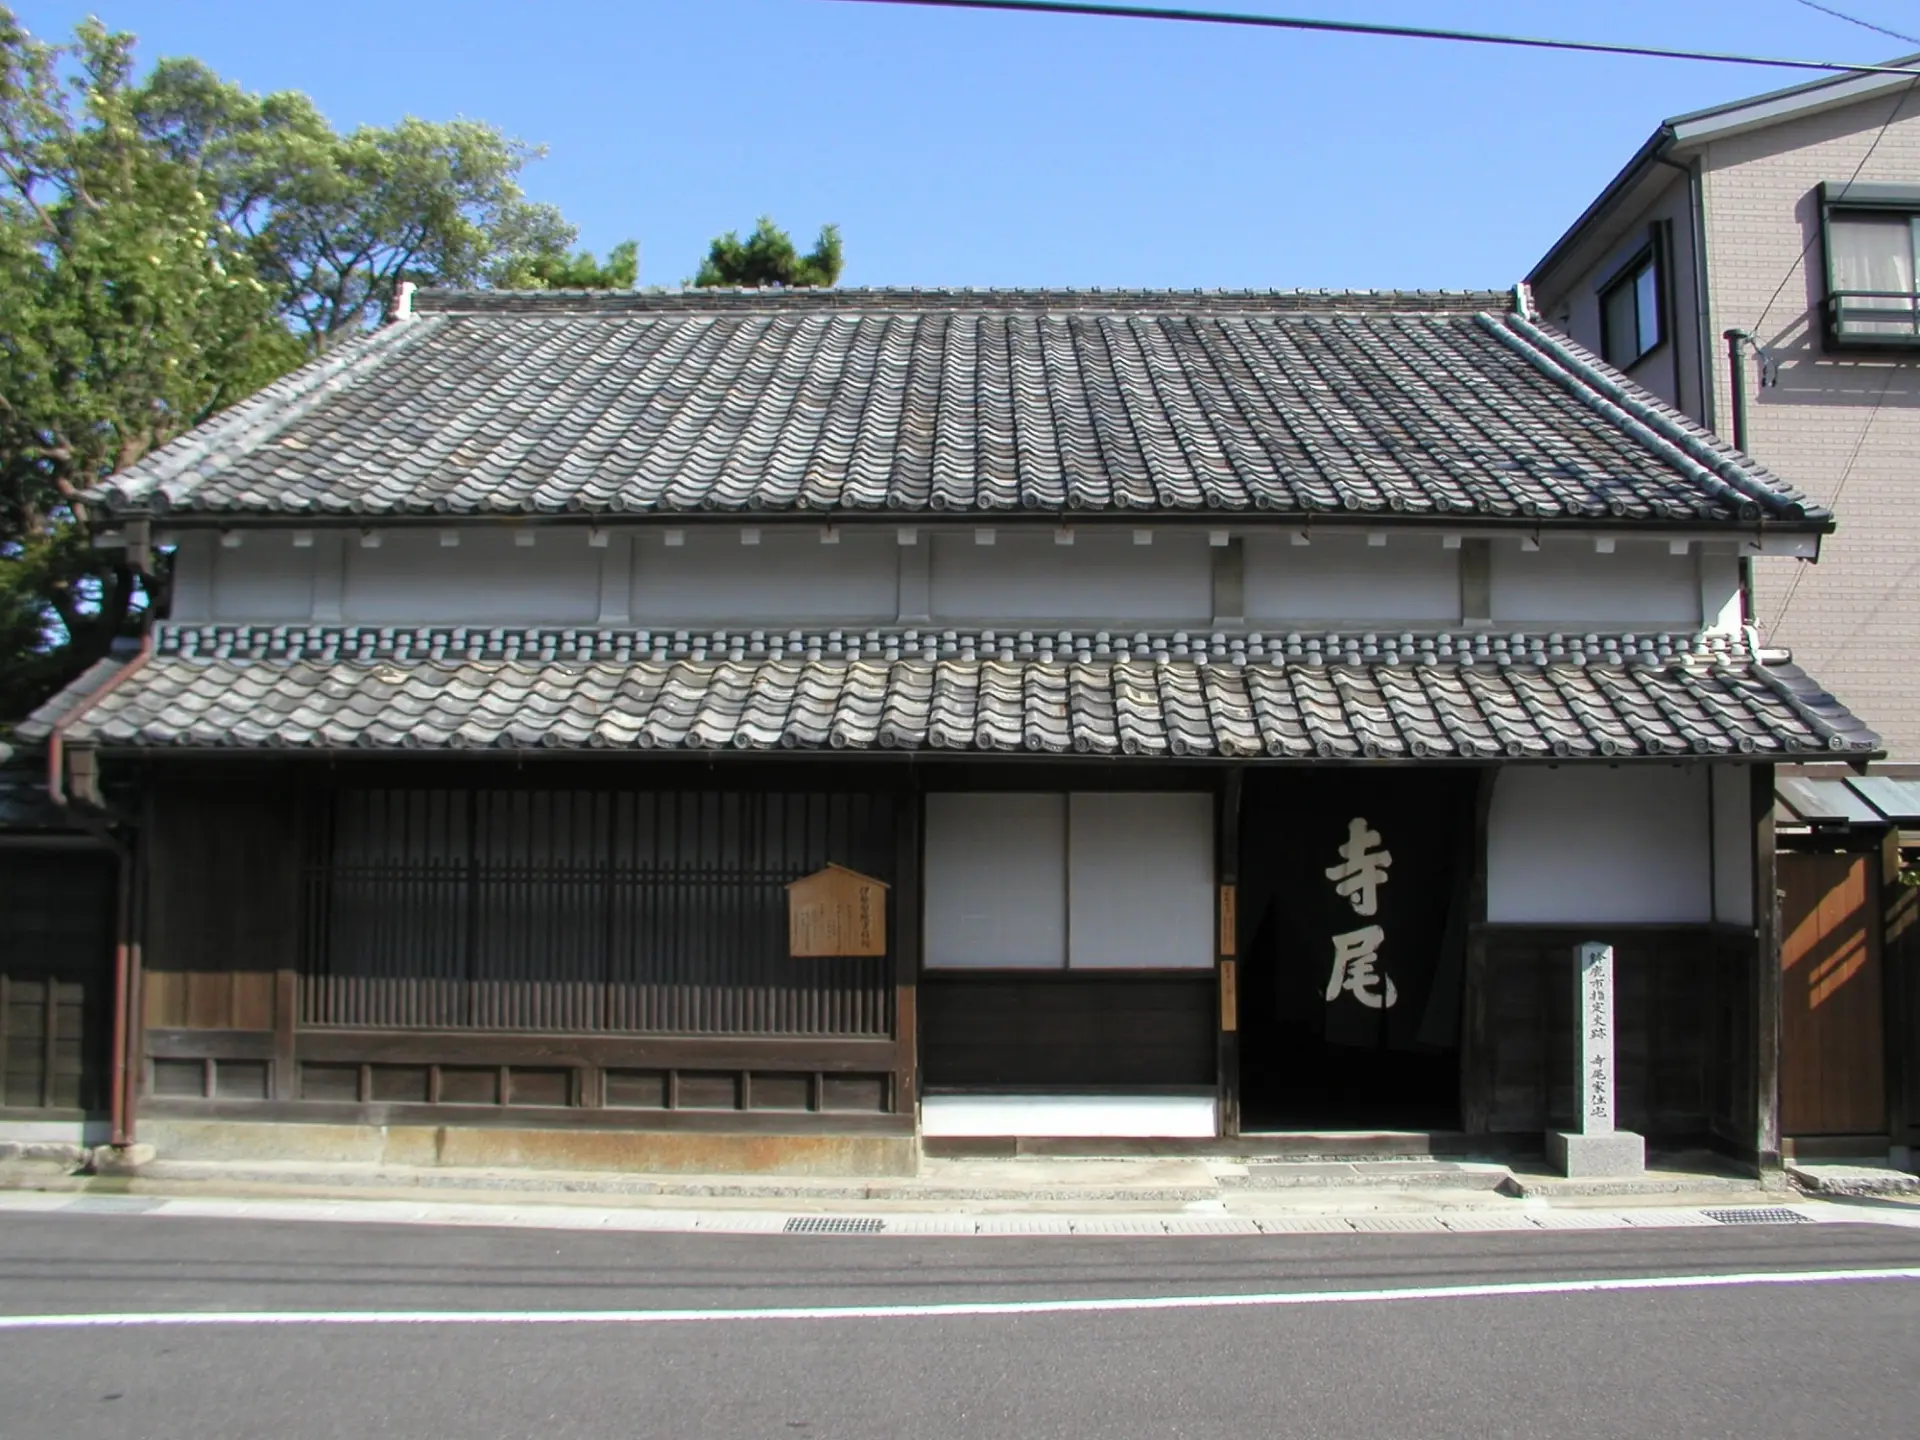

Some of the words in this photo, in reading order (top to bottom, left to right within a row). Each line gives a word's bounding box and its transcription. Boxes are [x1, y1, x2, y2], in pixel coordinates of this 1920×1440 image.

[1325, 817, 1398, 1008] 寺尾
[1590, 1054, 1608, 1118] 寺尾家住宅
